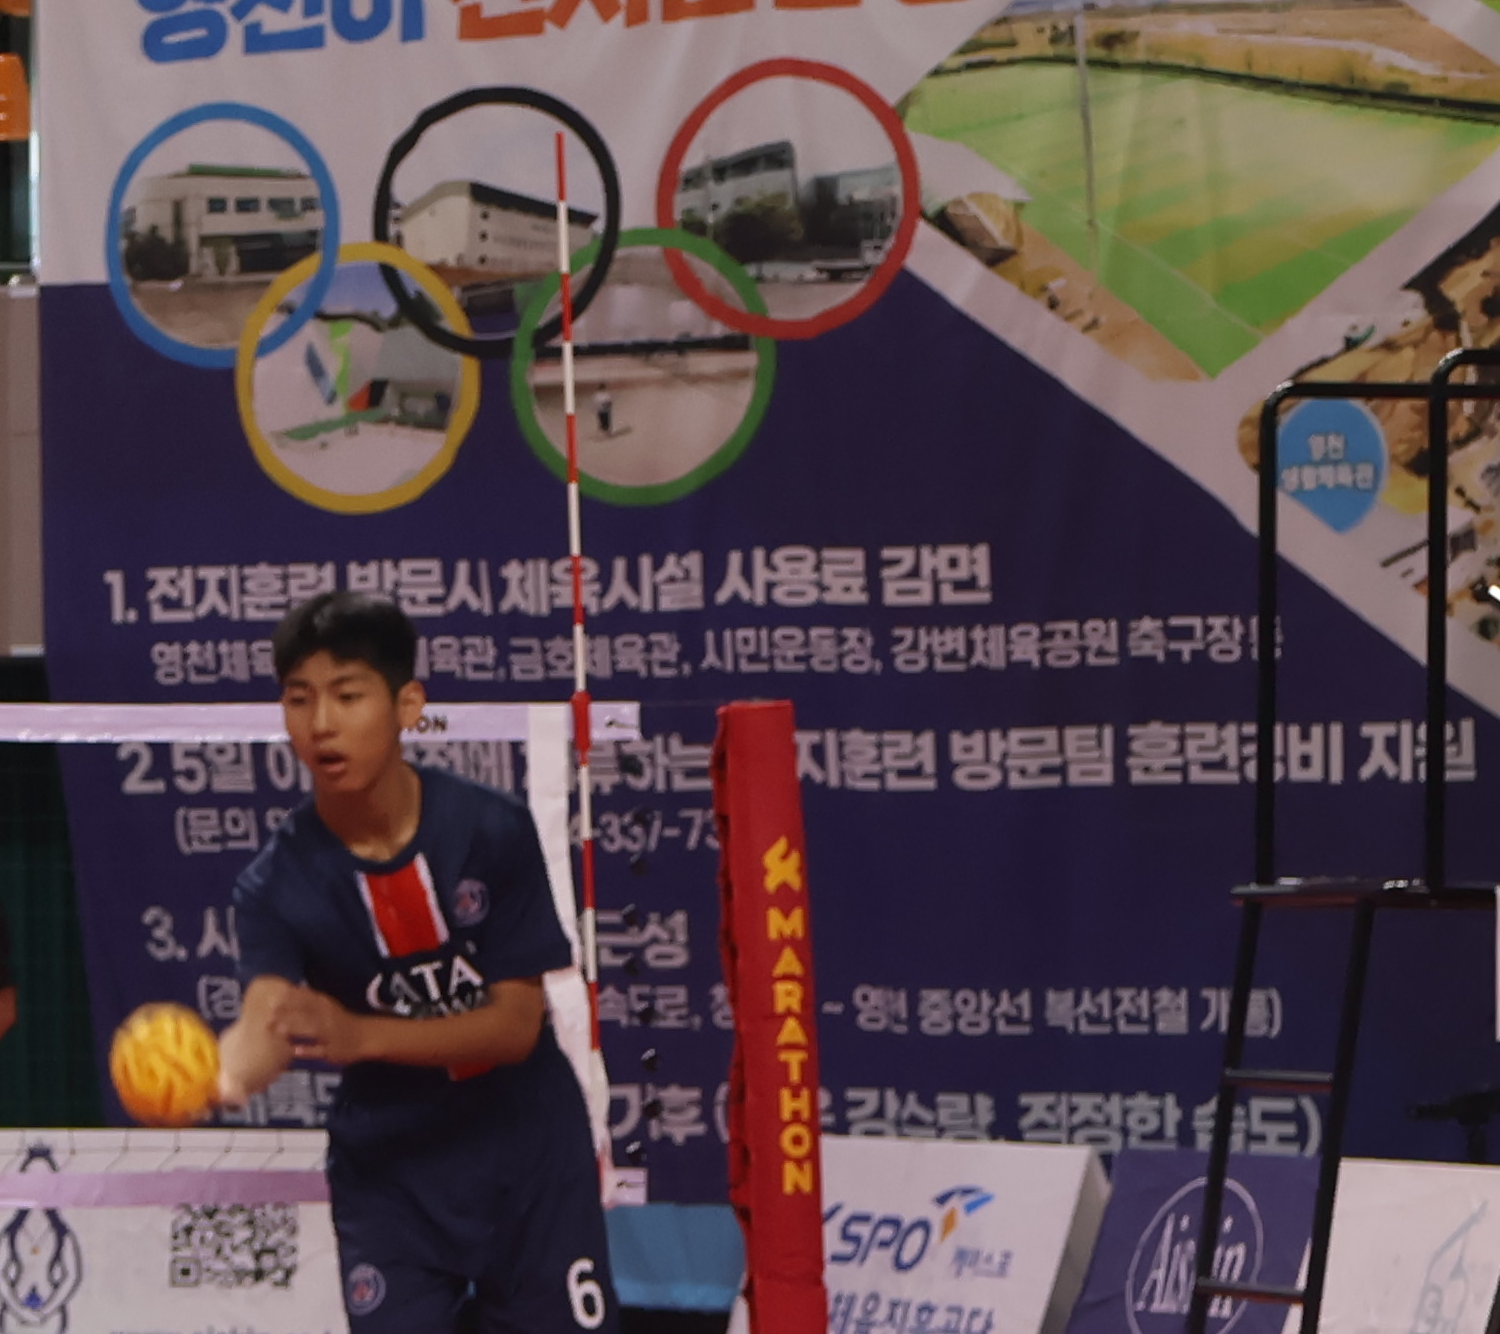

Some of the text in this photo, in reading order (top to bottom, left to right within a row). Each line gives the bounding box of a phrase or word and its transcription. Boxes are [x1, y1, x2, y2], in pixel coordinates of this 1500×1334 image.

[104, 542, 993, 624] 1. 전지훈련 방문시 체육시설 사용료 감면
[1127, 614, 1245, 664] 축구장
[796, 728, 938, 791] 지훈련
[949, 723, 1115, 791] 방문팀
[175, 806, 260, 856] (문의
[140, 905, 189, 962] 3.
[917, 986, 1034, 1036] 중앙선
[767, 906, 814, 1196] MARATHON
[566, 1258, 605, 1330] 6
